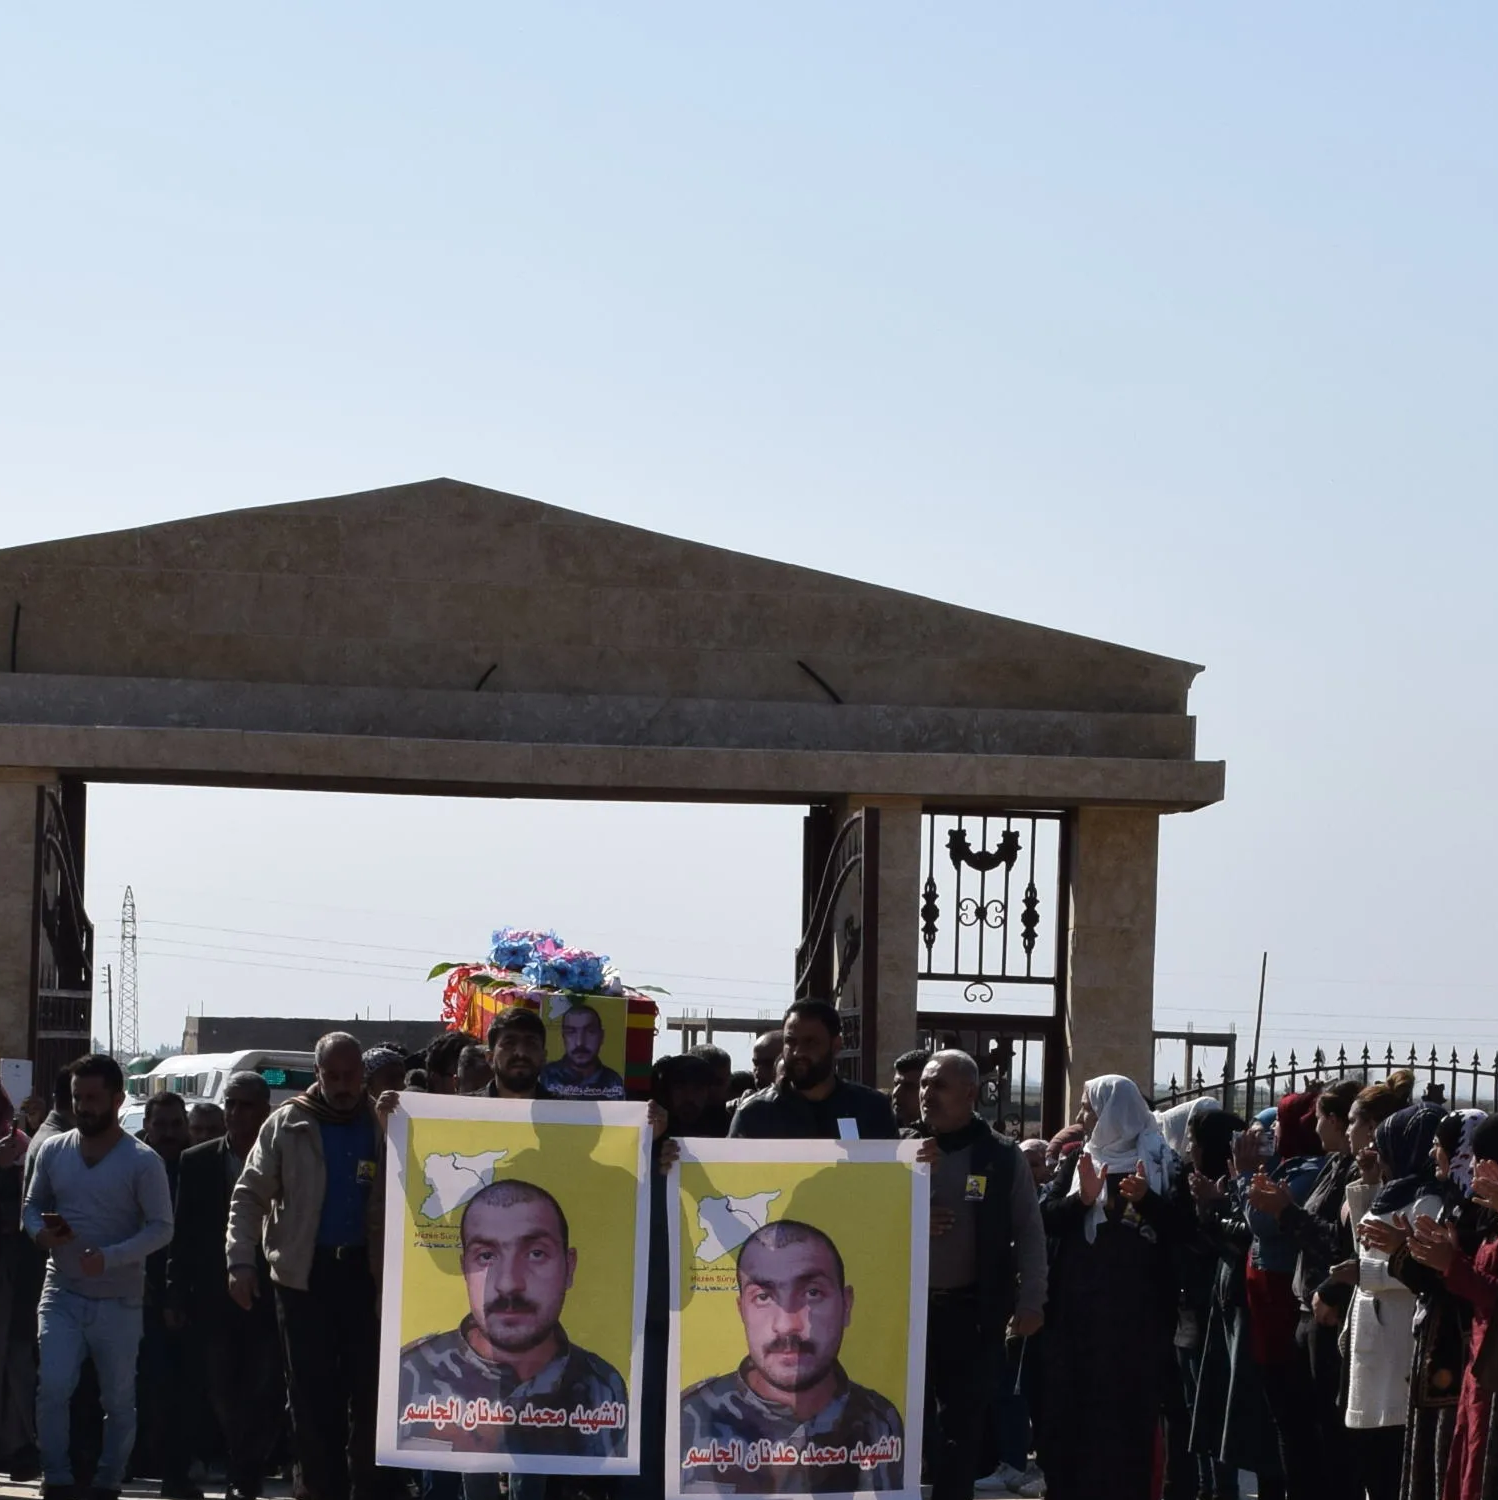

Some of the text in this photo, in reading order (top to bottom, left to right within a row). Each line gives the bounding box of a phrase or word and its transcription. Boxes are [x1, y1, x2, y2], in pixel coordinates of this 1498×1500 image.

[400, 1395, 625, 1433] الشهيد محمد عدنان الجاسم
[682, 1436, 900, 1473] الشهيد محمد عدنان الجاسم
